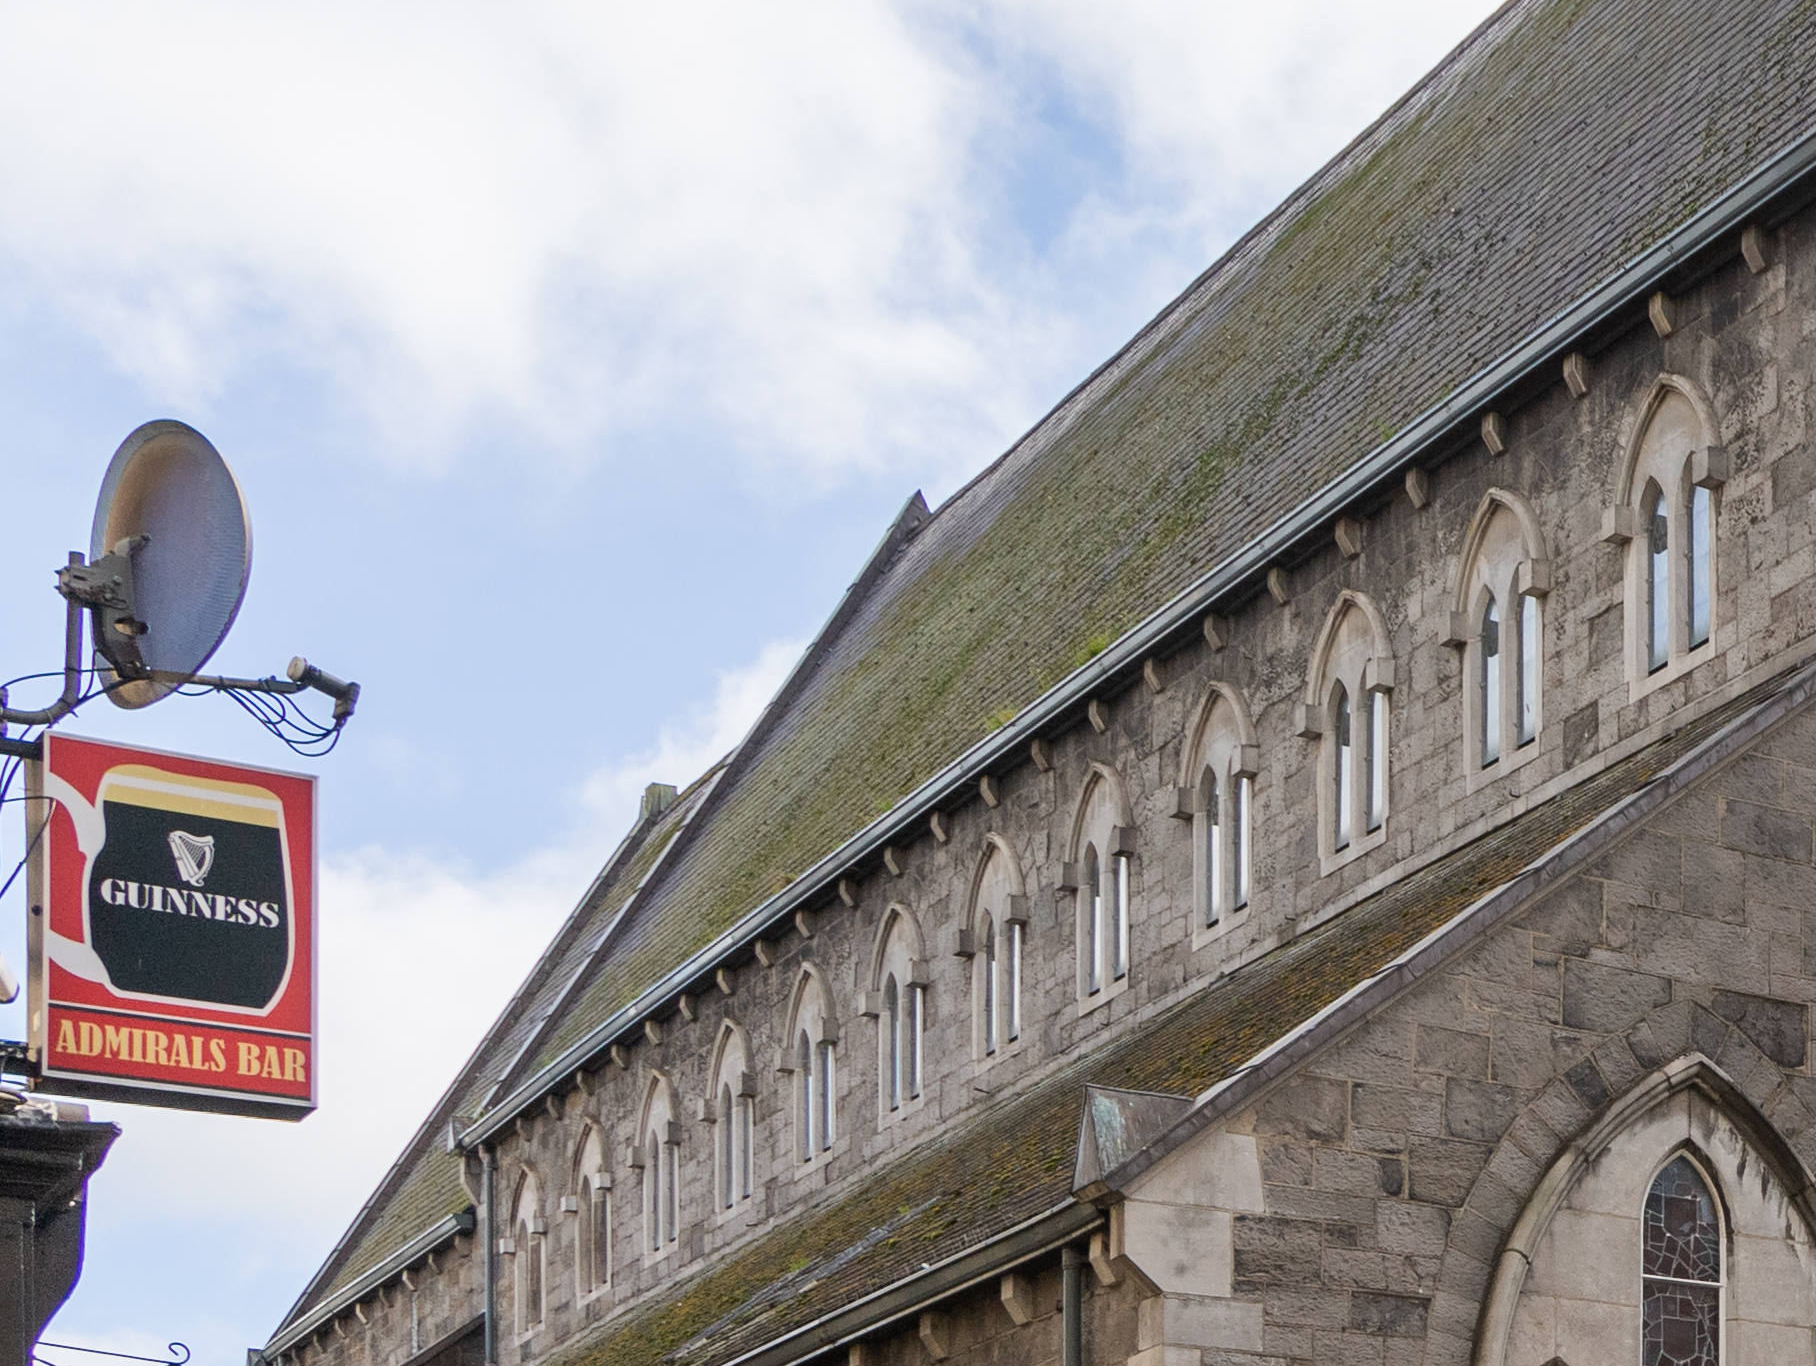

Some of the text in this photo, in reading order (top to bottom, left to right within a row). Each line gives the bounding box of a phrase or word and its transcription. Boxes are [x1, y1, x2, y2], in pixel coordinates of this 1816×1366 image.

[100, 877, 280, 929] GUINNESS
[55, 1018, 307, 1084] ADMIRALS BAR
